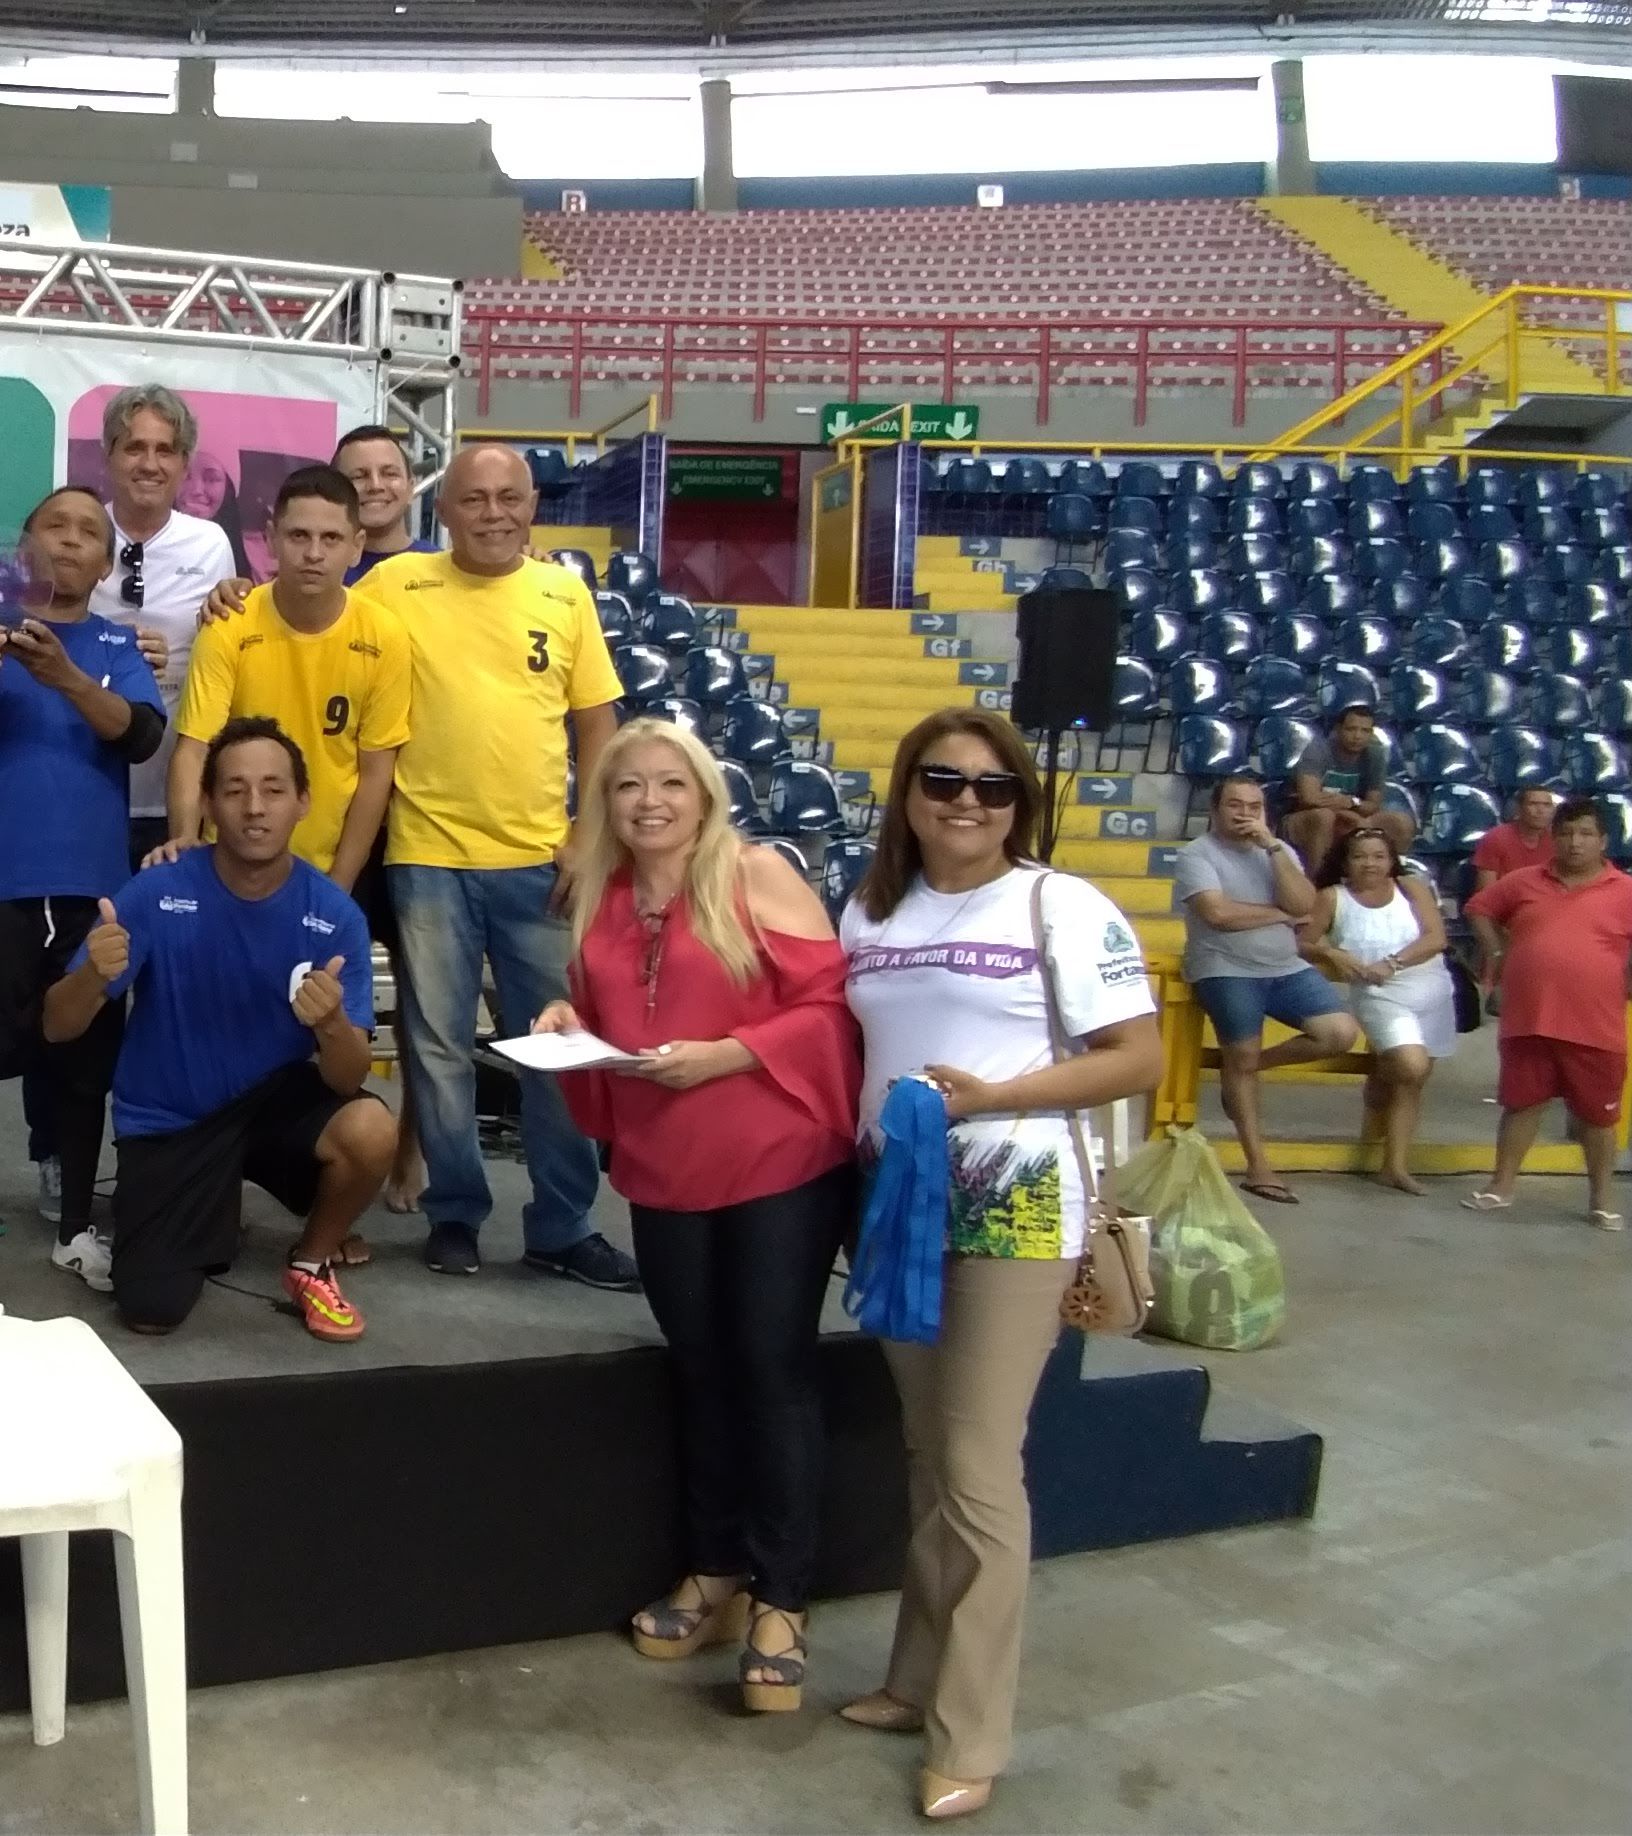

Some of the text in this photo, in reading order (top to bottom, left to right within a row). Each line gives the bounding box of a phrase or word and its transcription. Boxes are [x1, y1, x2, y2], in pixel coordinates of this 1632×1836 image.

[527, 629, 550, 673] 3
[323, 695, 350, 736] 9
[1106, 811, 1148, 836] Gc
[888, 953, 901, 966] A
[953, 949, 978, 966] DA
[984, 953, 1024, 969] VIDA
